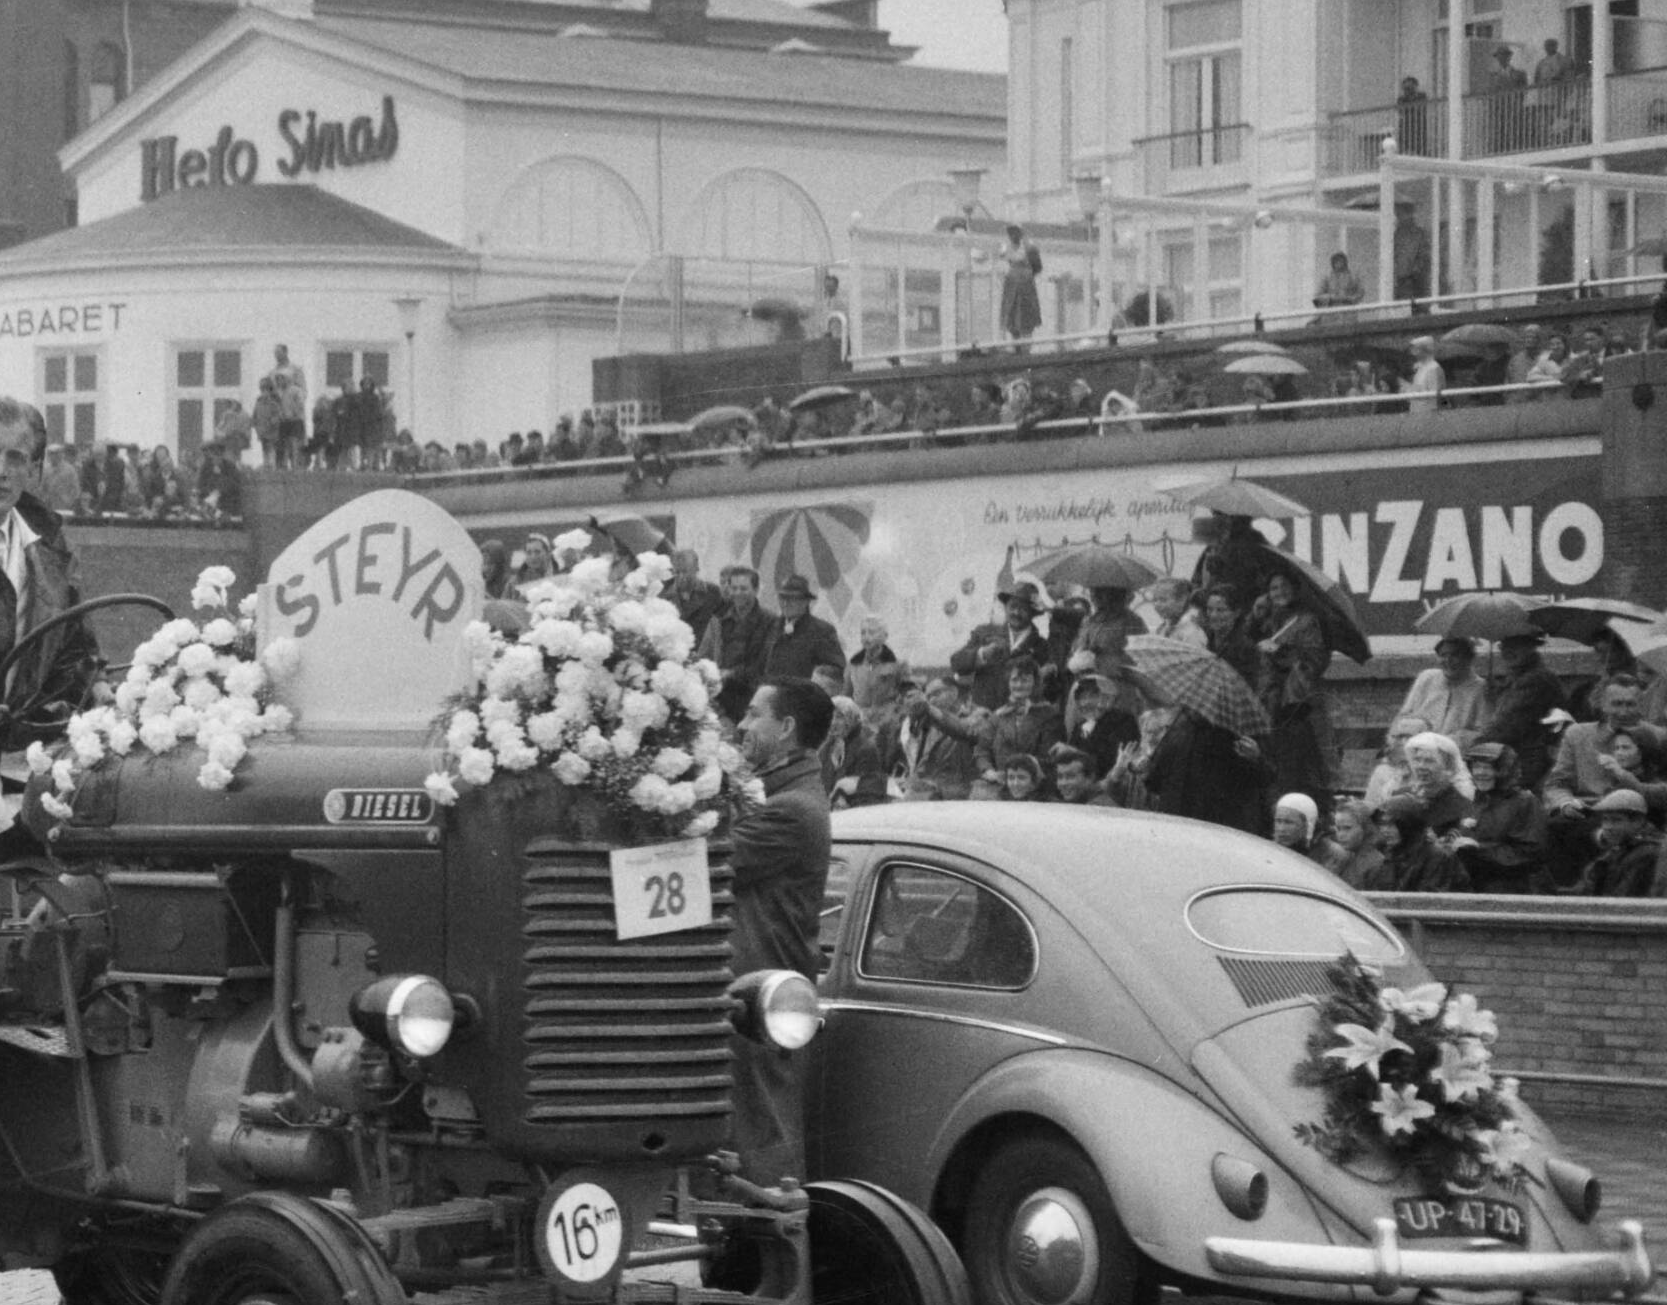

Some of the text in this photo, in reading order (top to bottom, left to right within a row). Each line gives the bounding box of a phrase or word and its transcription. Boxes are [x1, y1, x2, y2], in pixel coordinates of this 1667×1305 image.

[275, 522, 465, 643] STEYR
[350, 793, 422, 818] DIESEL
[643, 871, 686, 919] 28
[553, 1203, 619, 1266] 16 km
